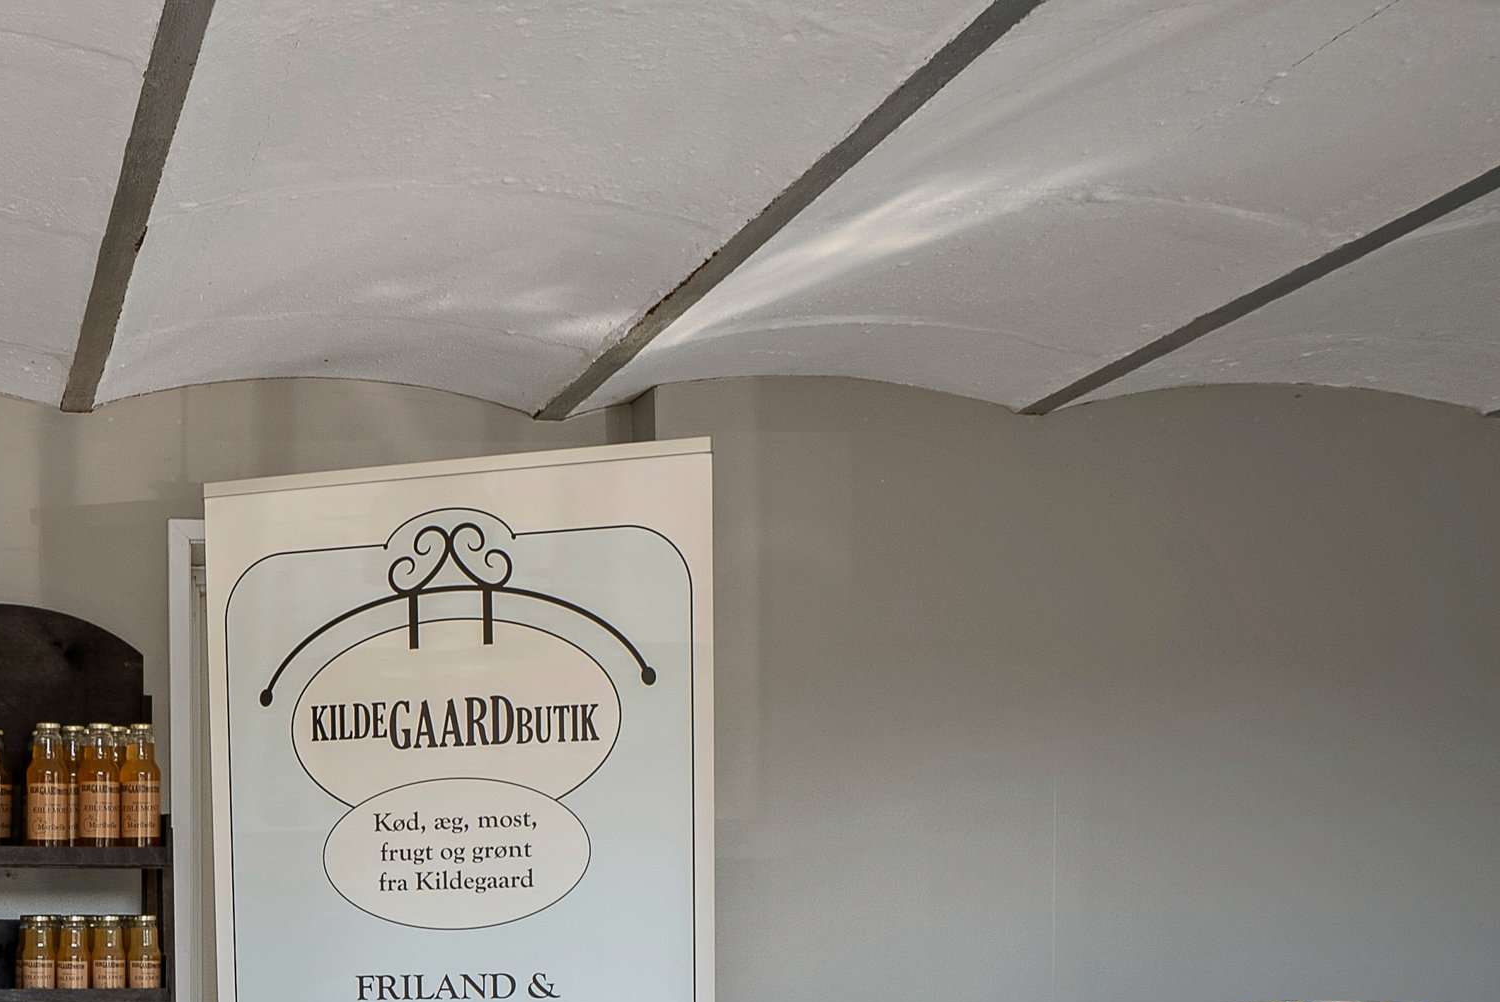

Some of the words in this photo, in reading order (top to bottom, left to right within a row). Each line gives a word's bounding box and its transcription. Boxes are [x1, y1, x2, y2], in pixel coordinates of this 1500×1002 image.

[310, 695, 600, 750] KILDEGAARDBUTIK
[373, 812, 426, 834] Kød,
[434, 816, 470, 834] æg,
[478, 811, 538, 831] most,
[380, 842, 433, 865] frugt
[440, 847, 466, 865] og
[472, 841, 533, 863] grønt
[378, 871, 408, 892] fra
[415, 868, 535, 894] Kildegaard
[356, 972, 517, 1001] FRILAND
[527, 972, 562, 999] &
